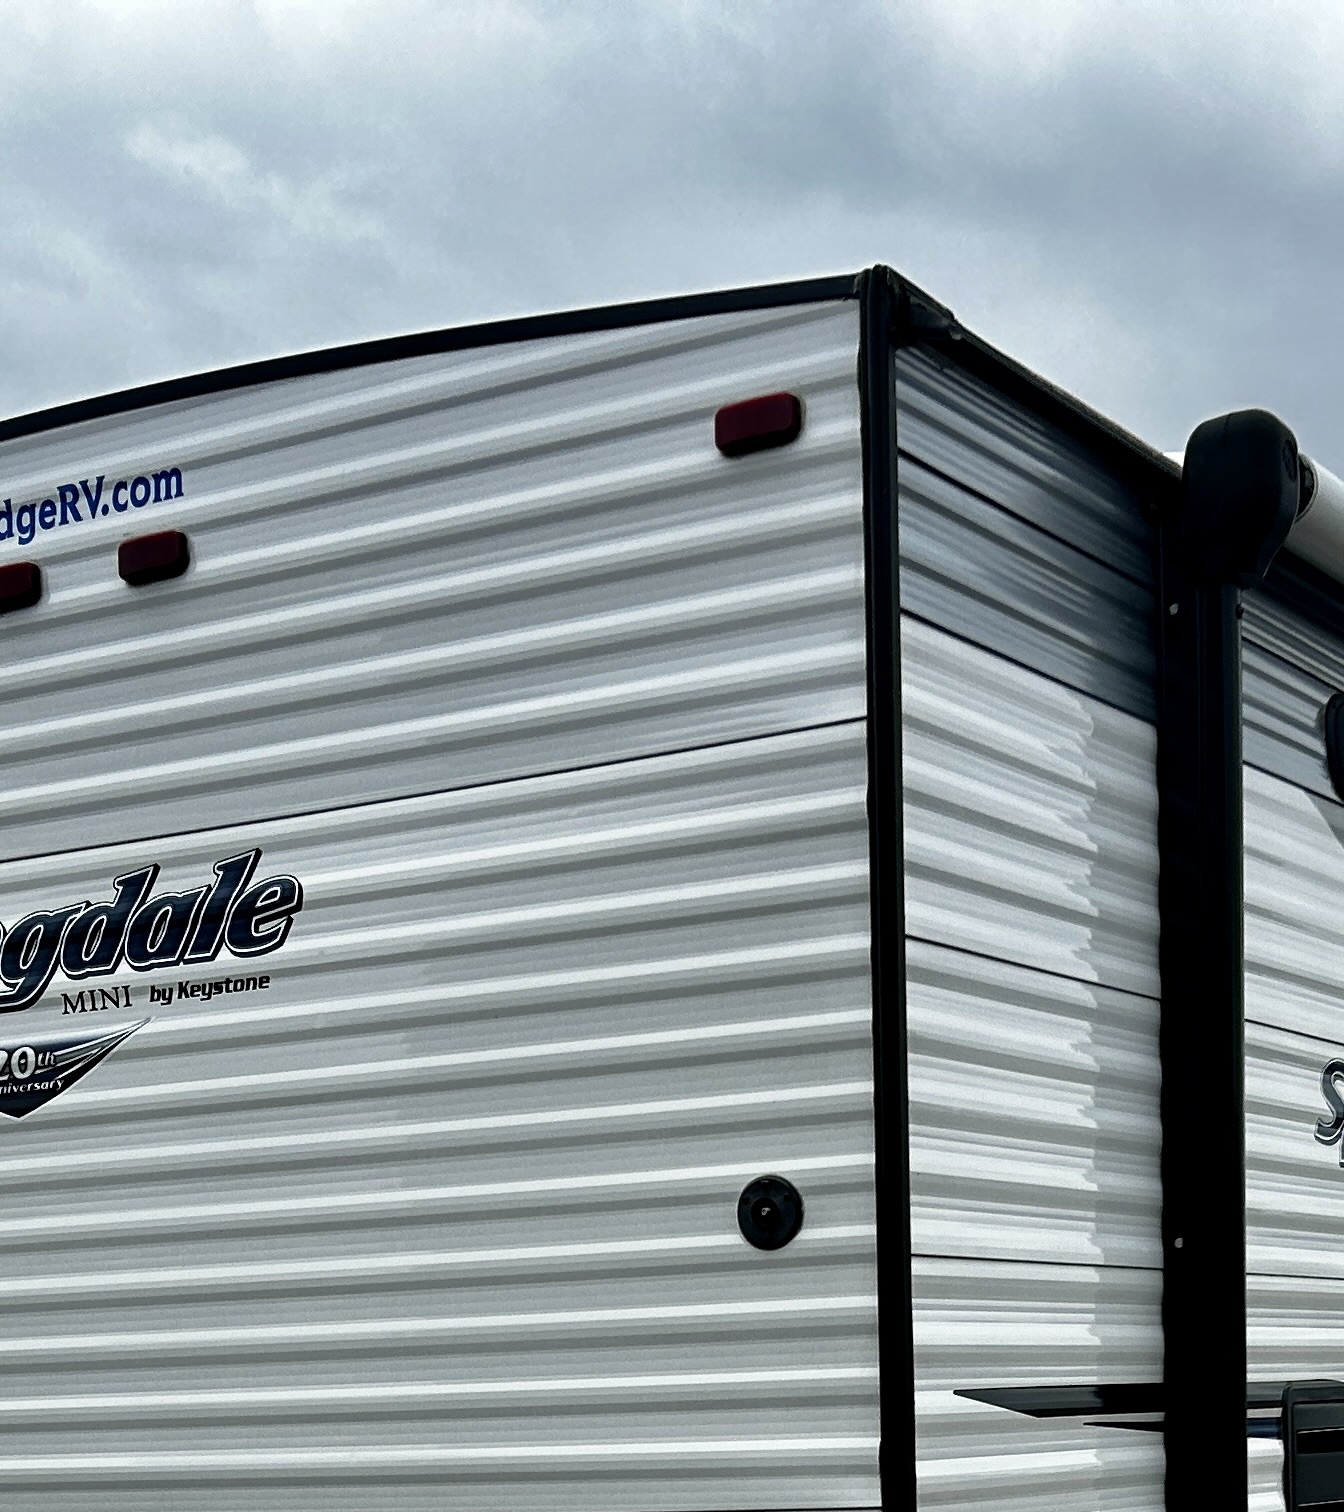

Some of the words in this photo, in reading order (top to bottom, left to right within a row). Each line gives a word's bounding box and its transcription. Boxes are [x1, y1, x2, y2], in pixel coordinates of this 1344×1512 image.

[61, 985, 135, 1015] MINI
[149, 985, 174, 1007] by
[176, 972, 271, 1003] Keystone
